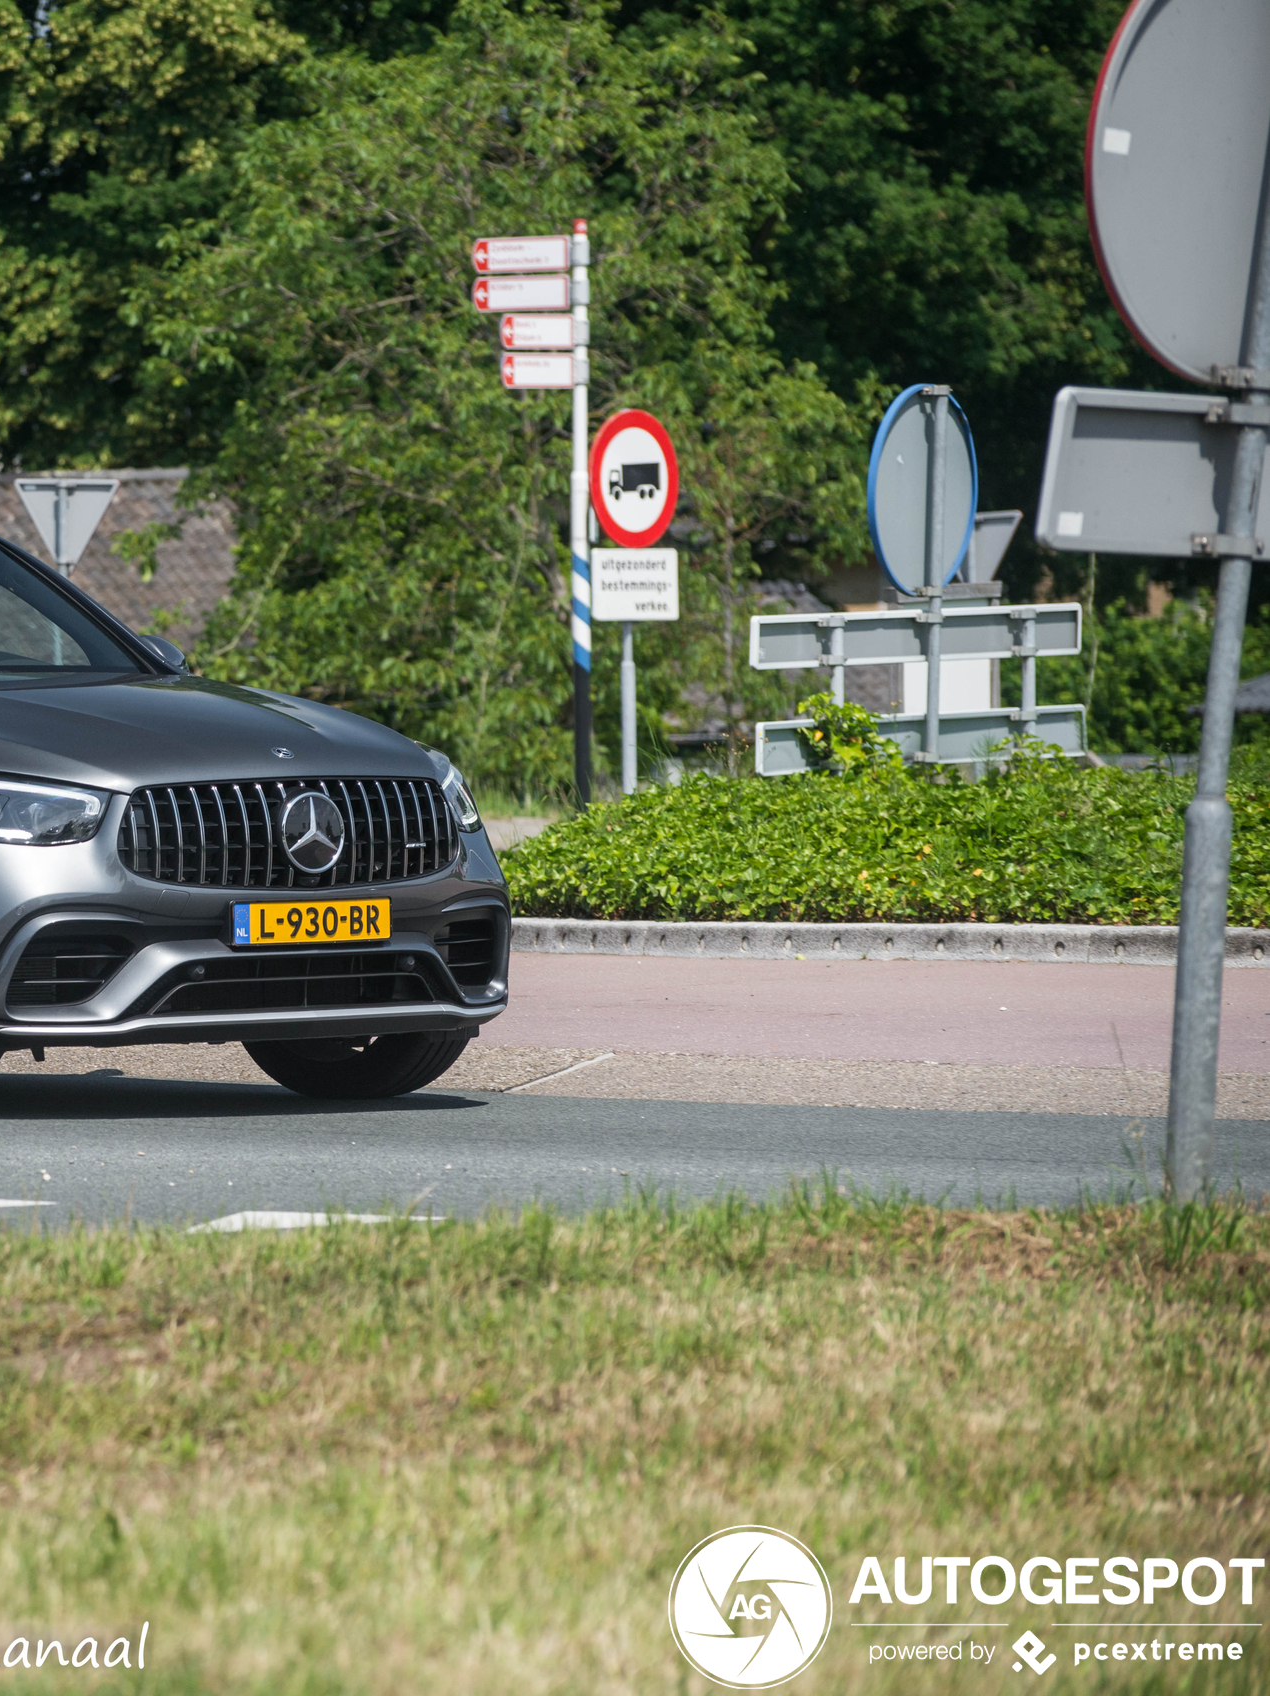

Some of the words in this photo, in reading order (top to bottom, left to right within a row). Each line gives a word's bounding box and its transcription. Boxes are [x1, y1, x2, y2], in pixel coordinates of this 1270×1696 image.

[601, 558, 666, 572] uitgezonderd
[601, 580, 672, 594] bestemmings-
[260, 905, 380, 938] L-930-BR
[236, 928, 248, 937] NL
